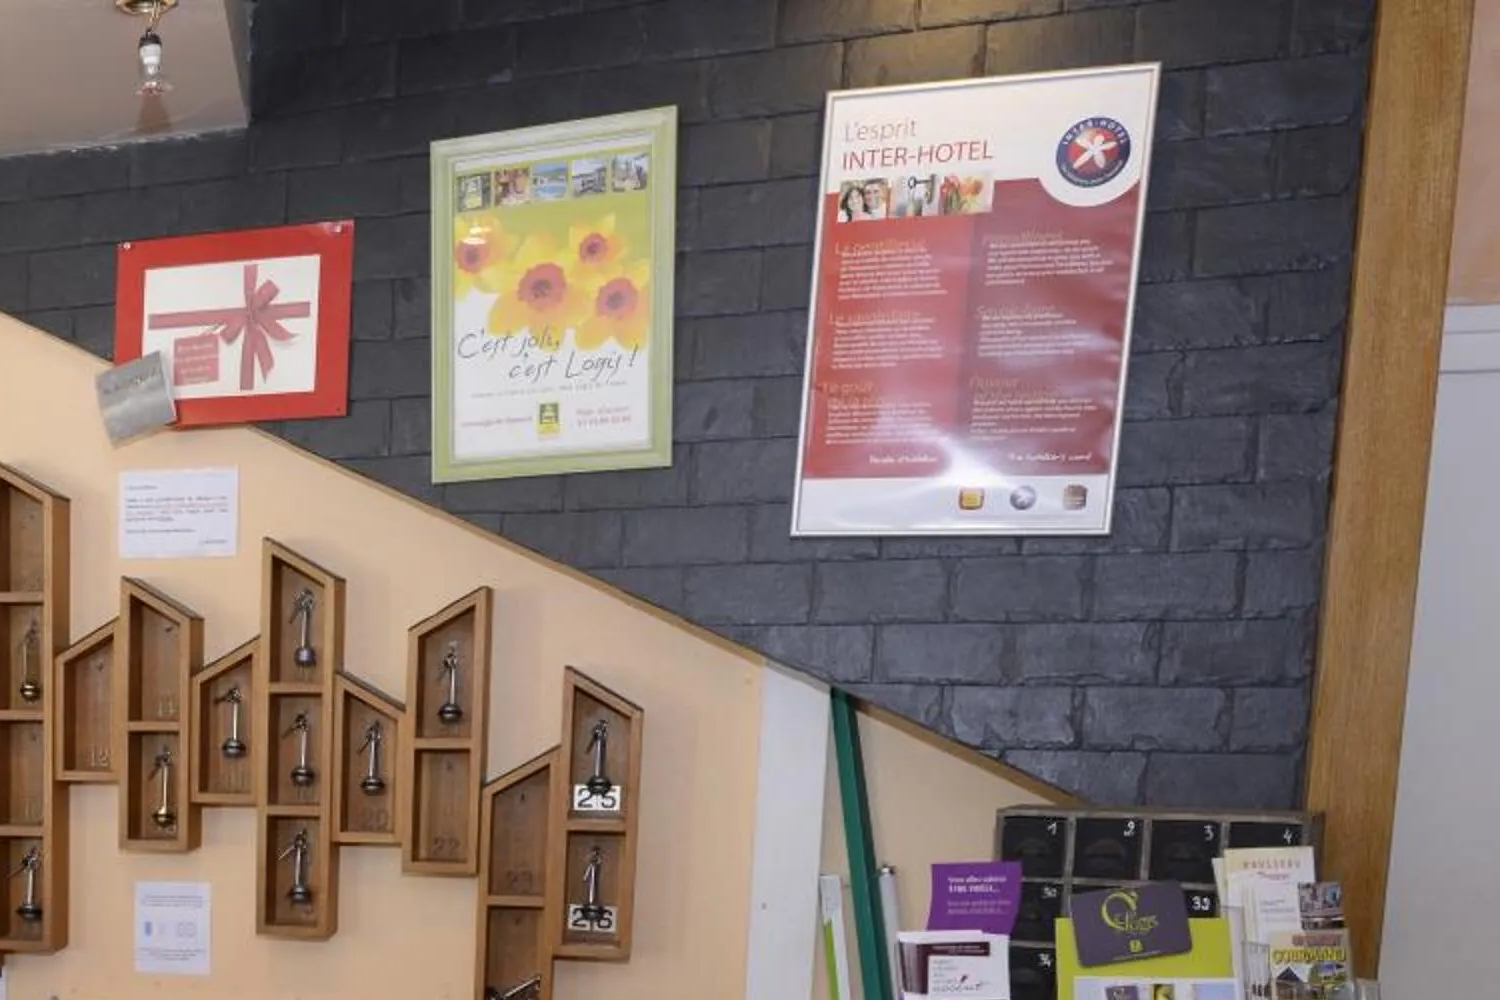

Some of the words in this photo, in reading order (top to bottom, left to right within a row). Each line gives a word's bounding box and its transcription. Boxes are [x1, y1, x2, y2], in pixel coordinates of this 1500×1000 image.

[844, 118, 917, 143] L'esprit
[842, 140, 994, 170] INTER-HOTEL
[577, 788, 616, 808] 25
[572, 908, 613, 928] 26
